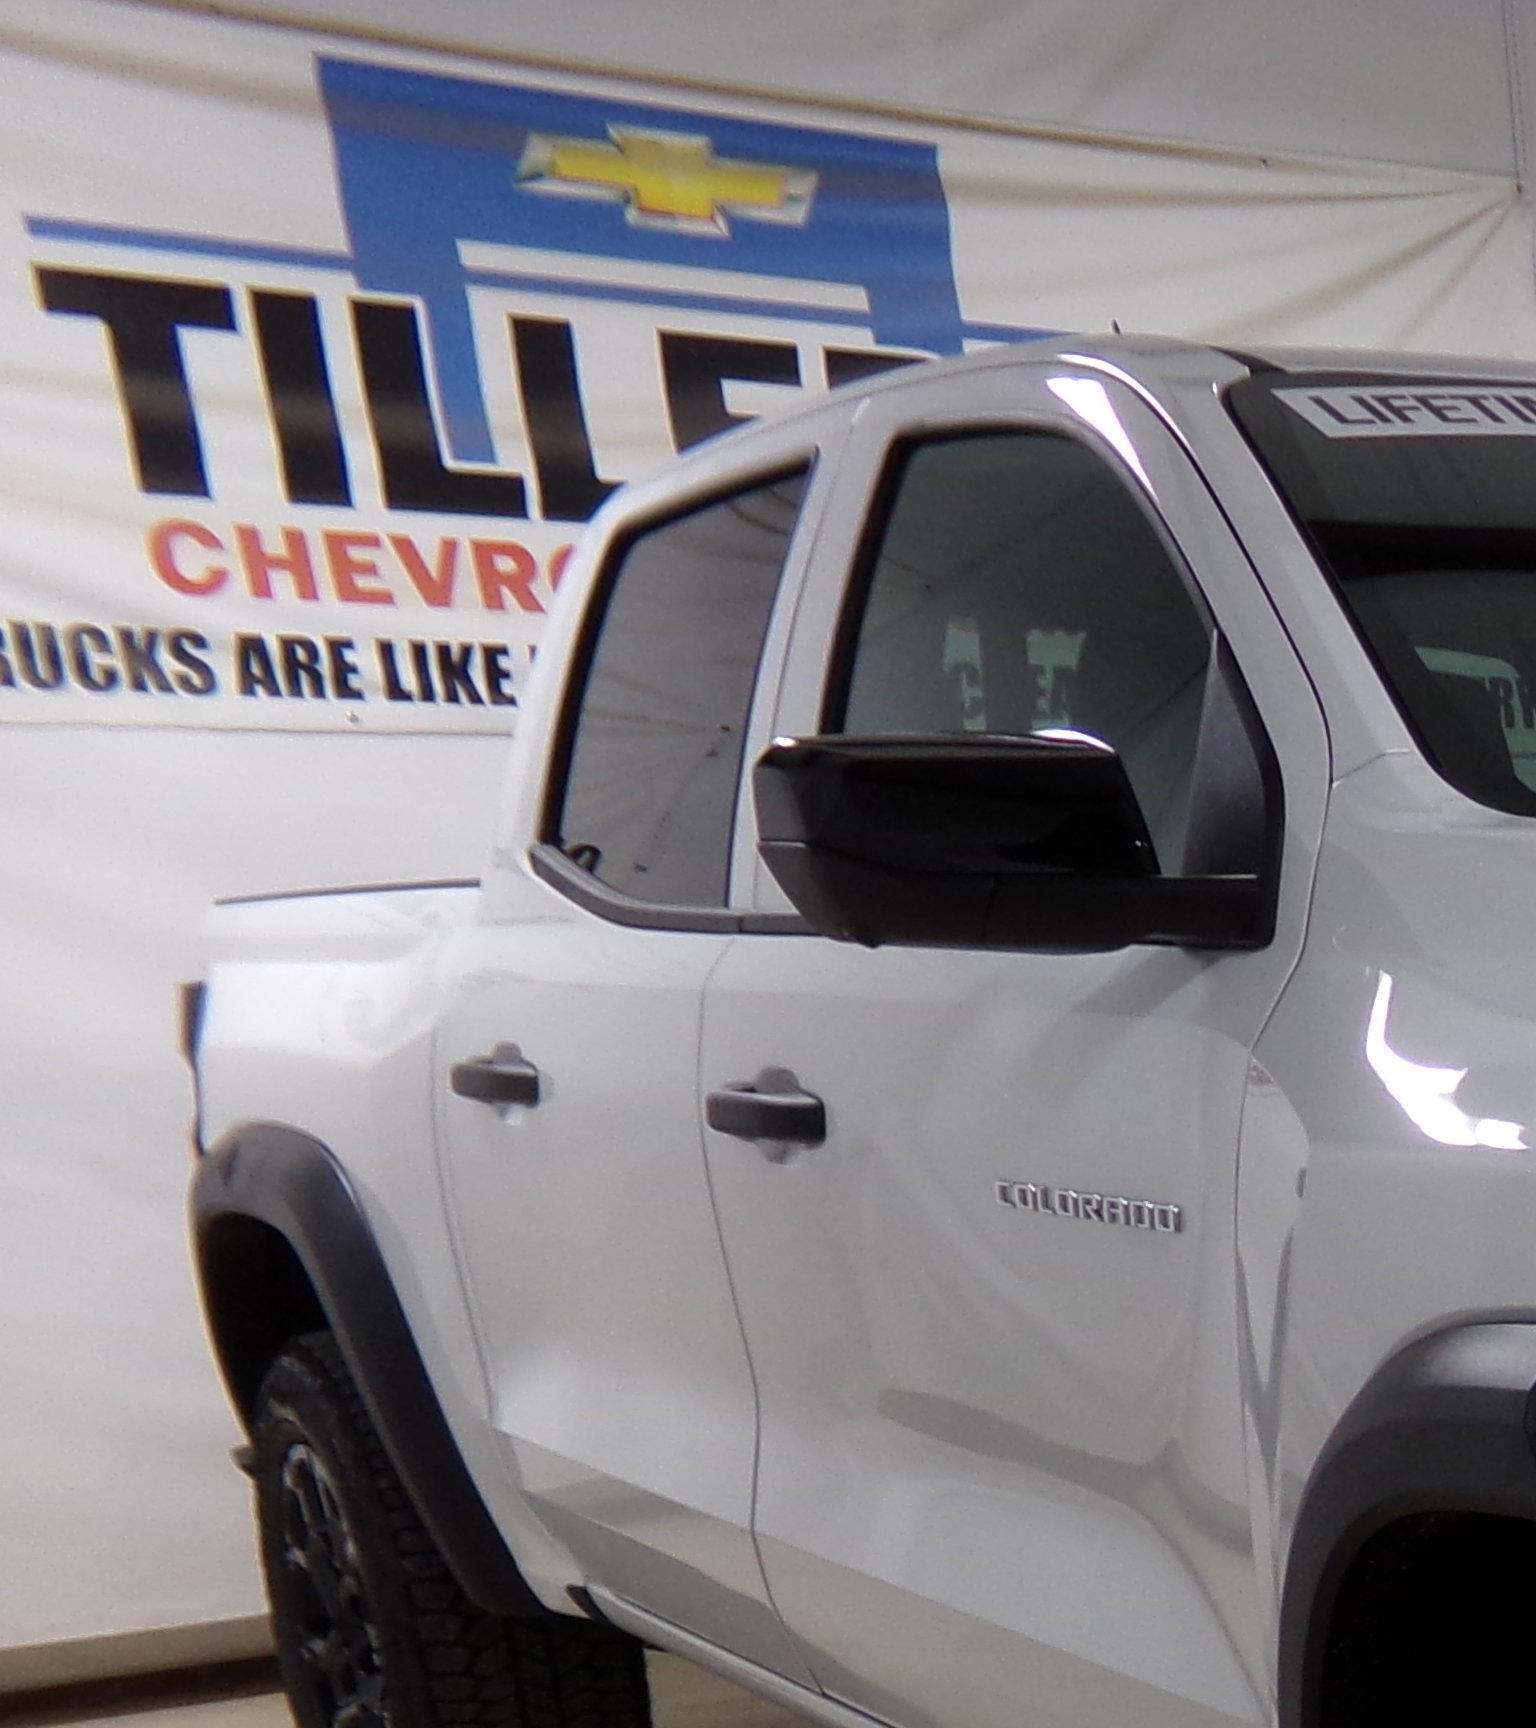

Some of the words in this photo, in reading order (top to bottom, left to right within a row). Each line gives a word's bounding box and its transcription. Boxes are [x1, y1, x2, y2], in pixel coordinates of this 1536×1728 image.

[32, 264, 935, 522] TILLE
[145, 516, 574, 615] CHEVR
[231, 631, 366, 701] ARE
[373, 637, 519, 707] LIKE
[994, 1180, 1183, 1233] COLORADO
